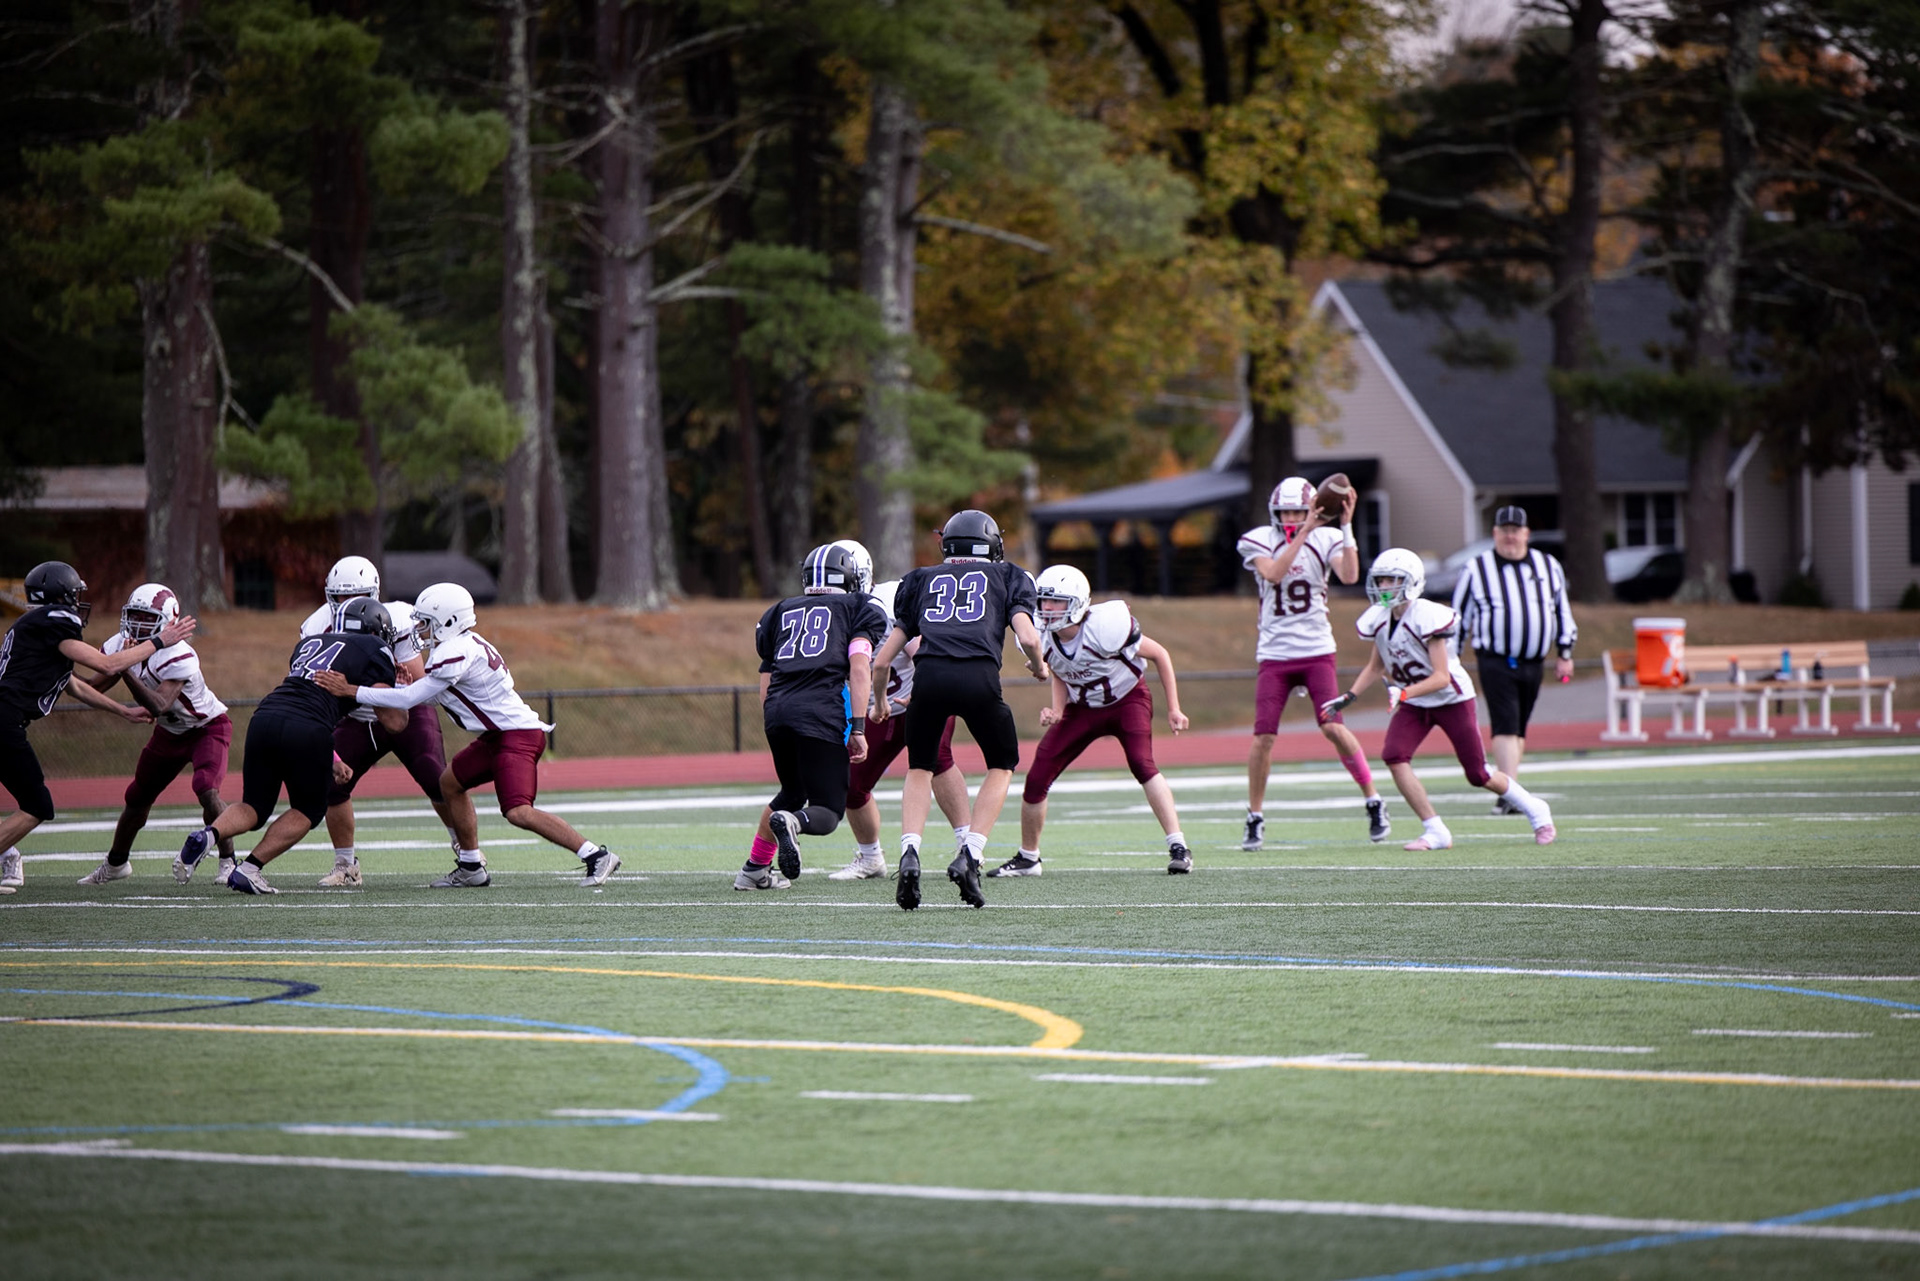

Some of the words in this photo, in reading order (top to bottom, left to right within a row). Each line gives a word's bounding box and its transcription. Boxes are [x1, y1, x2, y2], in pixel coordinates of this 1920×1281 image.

[924, 570, 988, 622] 33
[1272, 579, 1311, 616] 19
[777, 606, 832, 659] 78
[288, 638, 346, 680] 24
[1065, 668, 1093, 680] RAMS
